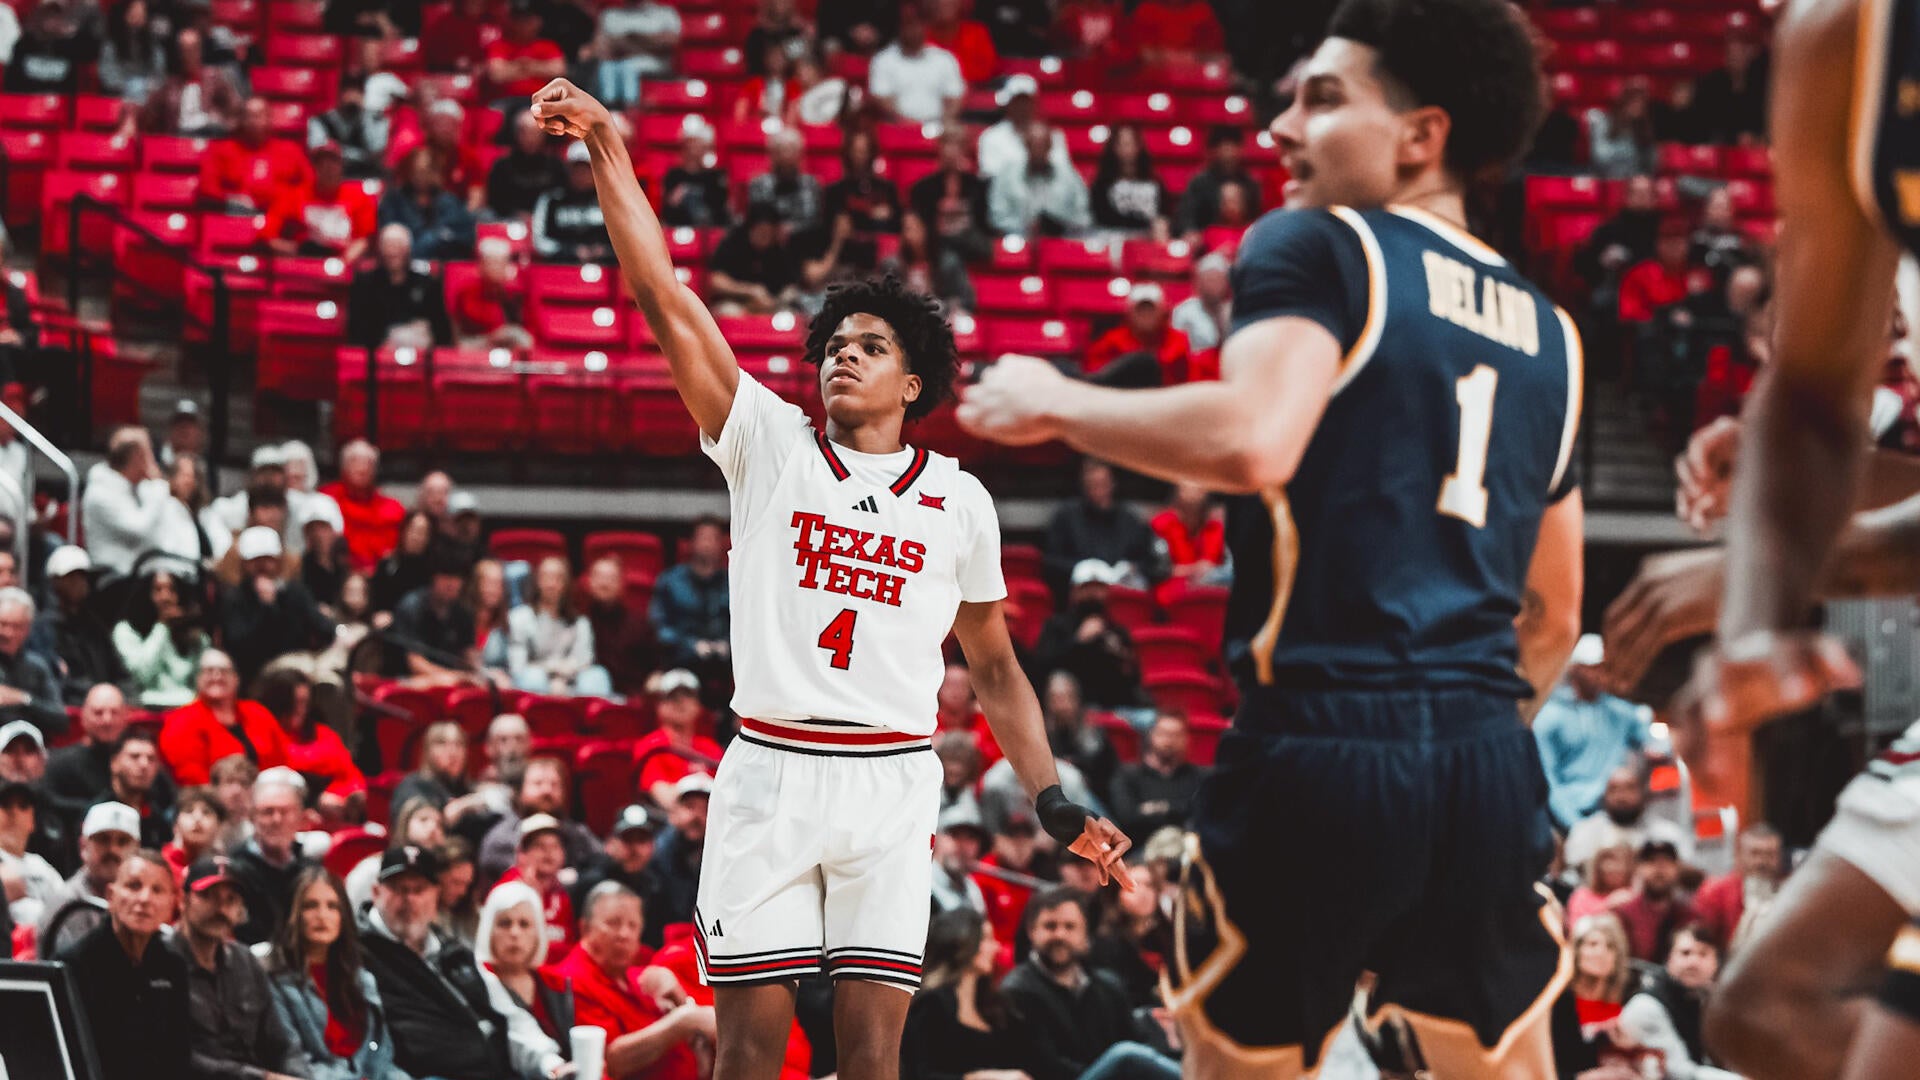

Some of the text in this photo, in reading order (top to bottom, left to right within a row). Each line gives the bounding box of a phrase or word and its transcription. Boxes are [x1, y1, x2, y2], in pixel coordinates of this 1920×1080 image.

[1436, 363, 1499, 529] 1
[791, 511, 926, 573] TEXAS
[796, 550, 906, 607] TECH
[818, 608, 857, 671] 4
